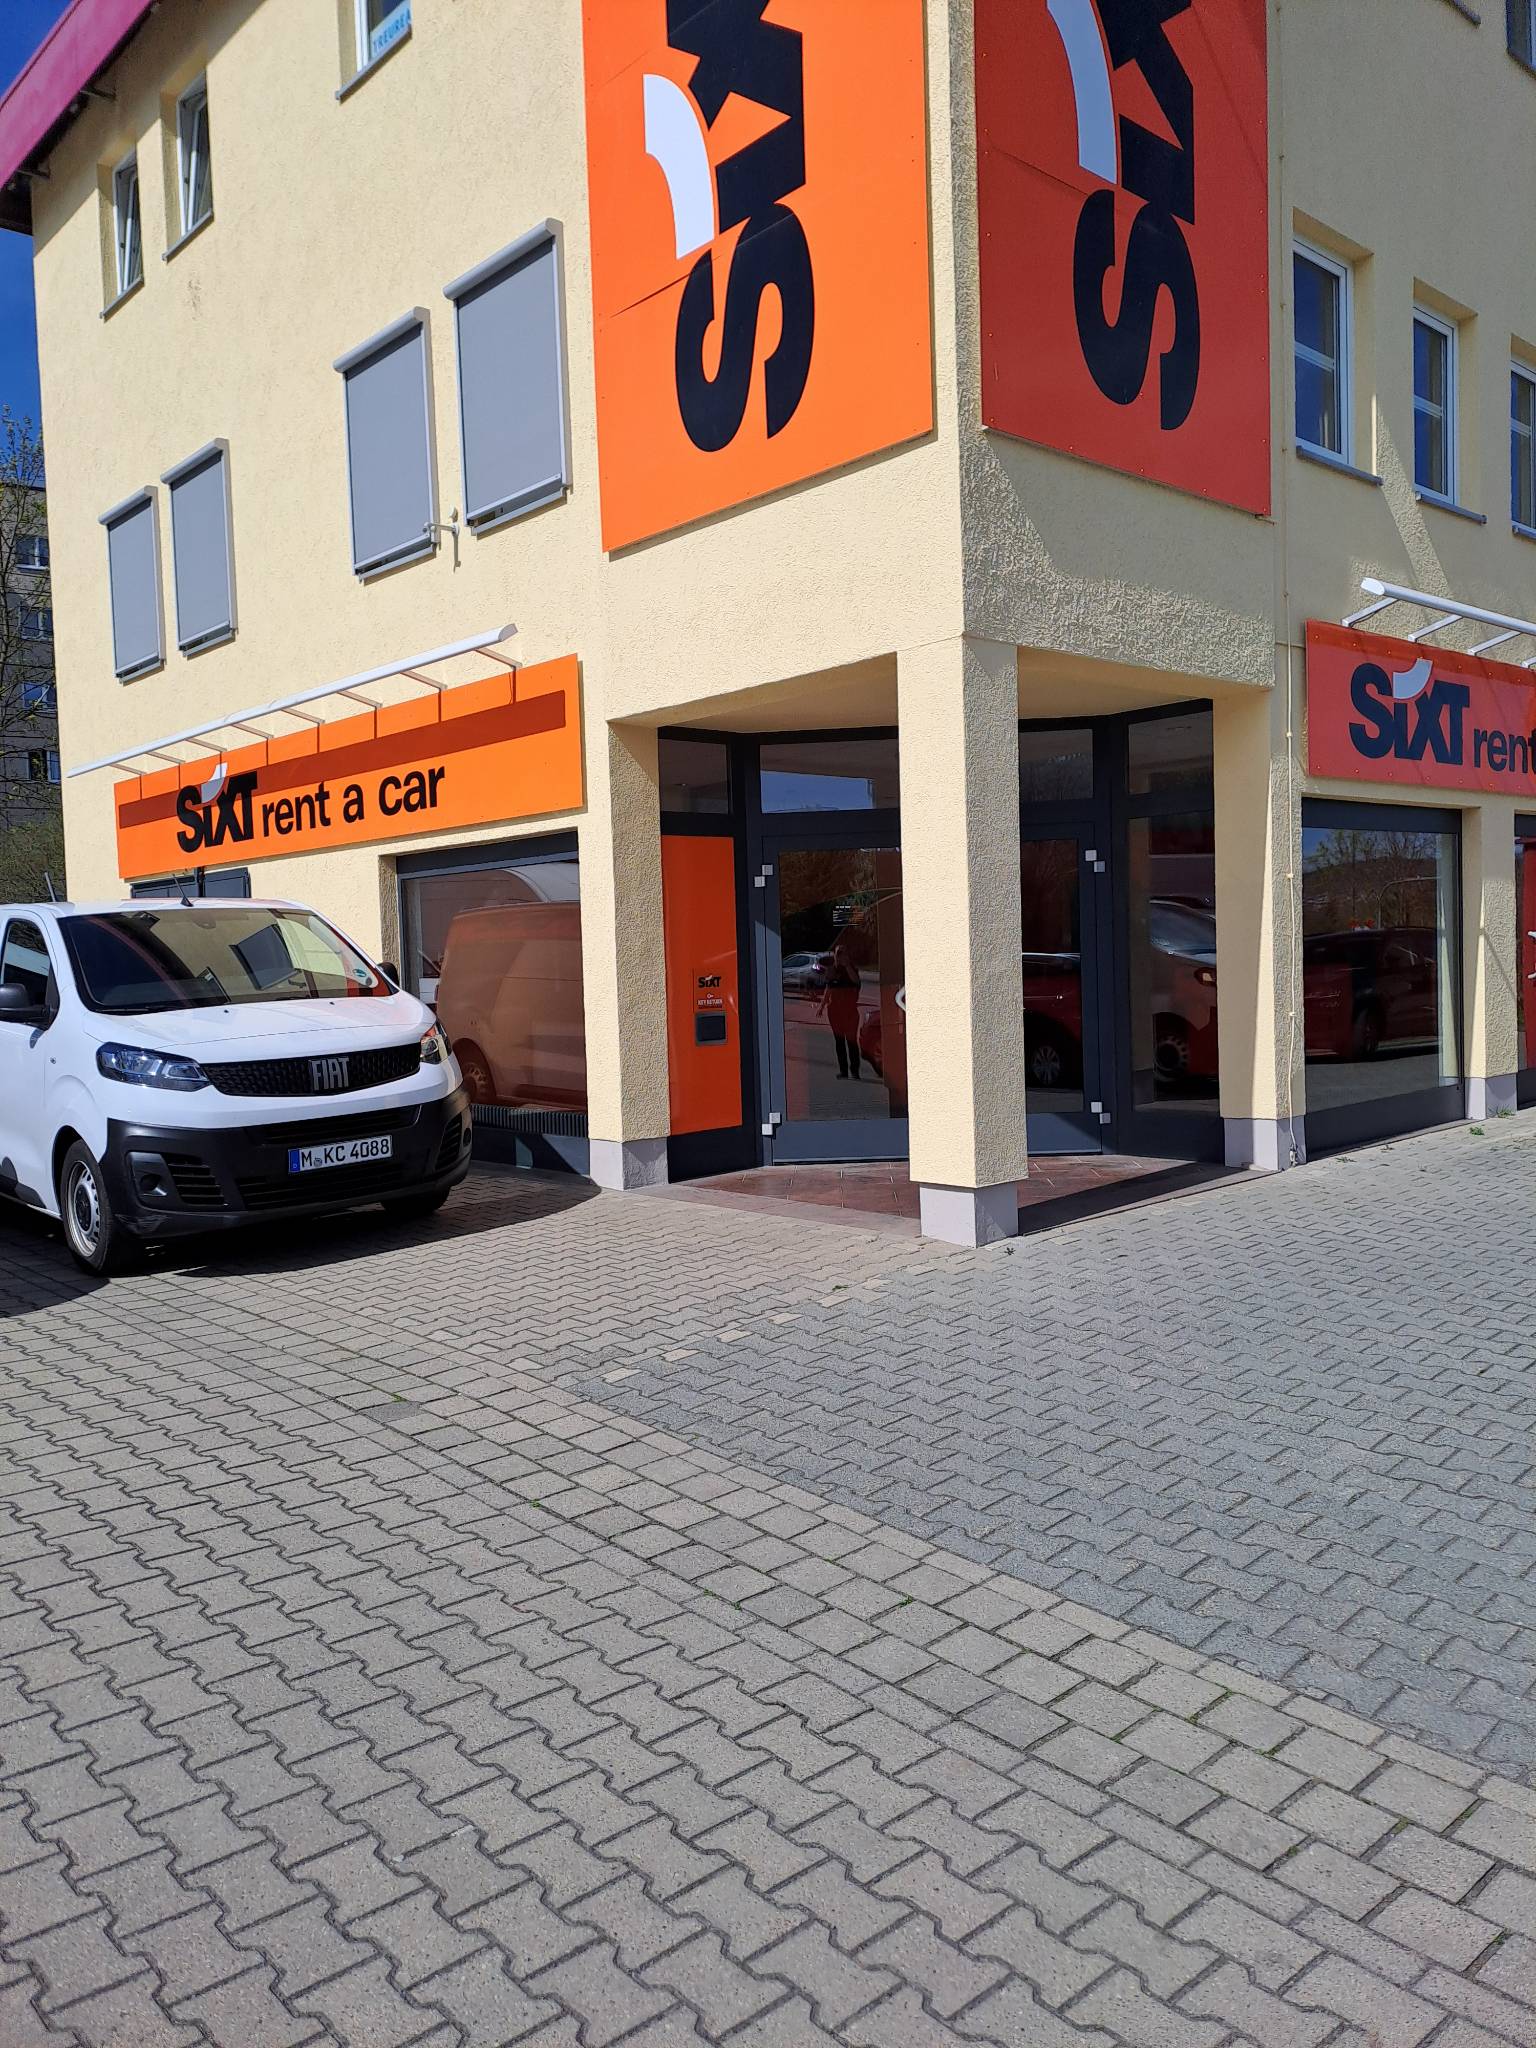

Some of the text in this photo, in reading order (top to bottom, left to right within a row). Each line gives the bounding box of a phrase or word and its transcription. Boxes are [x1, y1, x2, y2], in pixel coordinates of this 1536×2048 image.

[262, 781, 331, 837] rent
[342, 783, 365, 824] a
[378, 765, 445, 817] car
[309, 1057, 349, 1091] FIAT
[301, 1150, 313, 1168] M
[324, 1145, 346, 1164] KC
[350, 1138, 389, 1160] 4088
